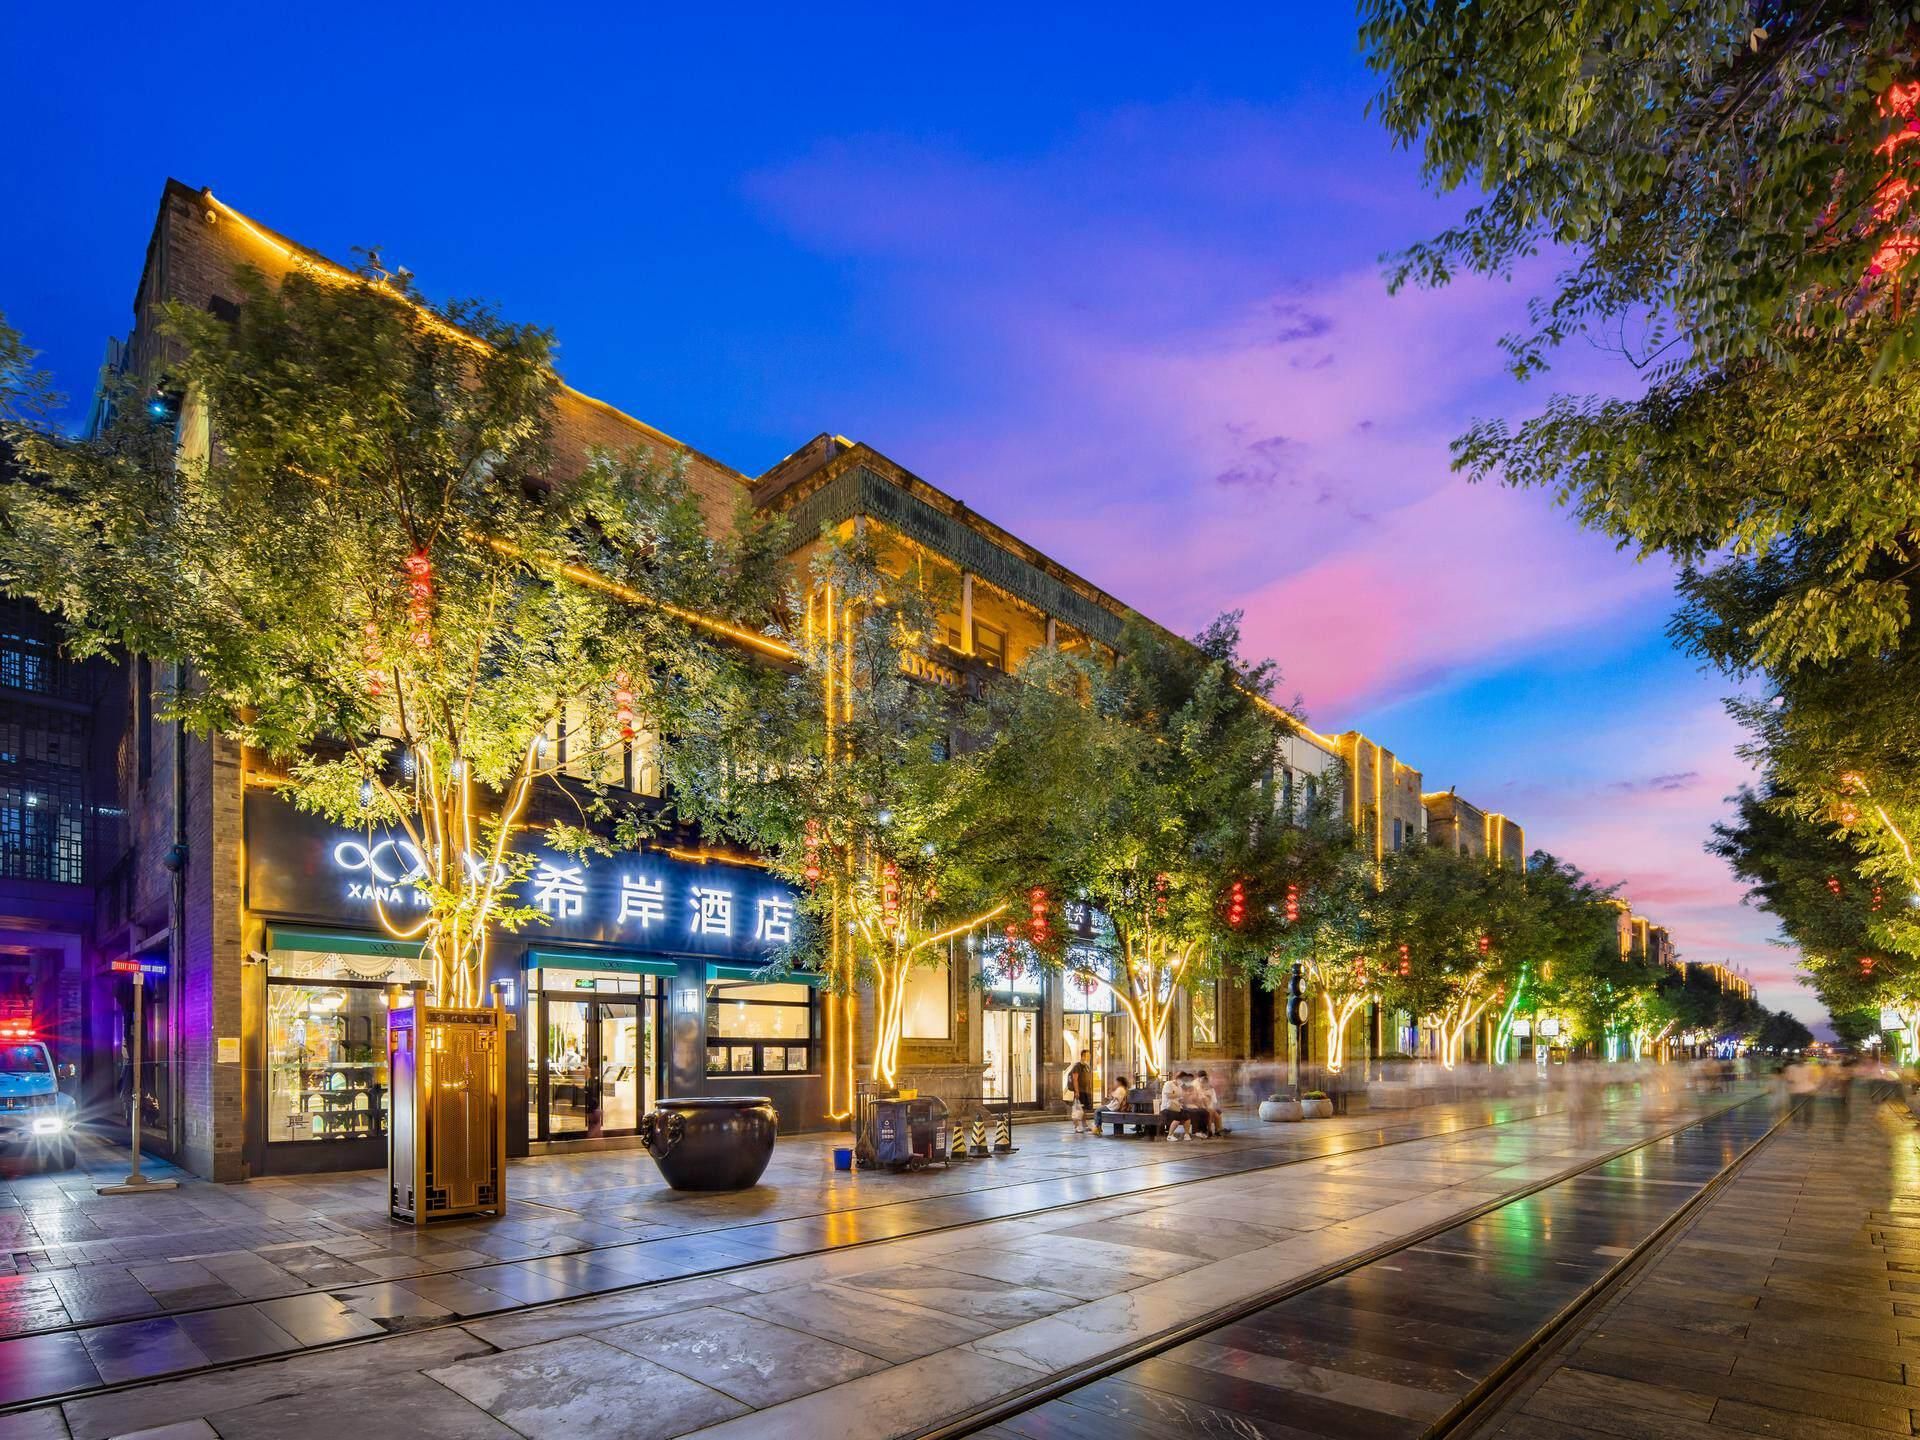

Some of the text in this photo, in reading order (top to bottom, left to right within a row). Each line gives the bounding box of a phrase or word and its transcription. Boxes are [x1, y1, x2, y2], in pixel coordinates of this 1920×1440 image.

[348, 884, 403, 904] XANA
[534, 863, 793, 943] 希岸酒店
